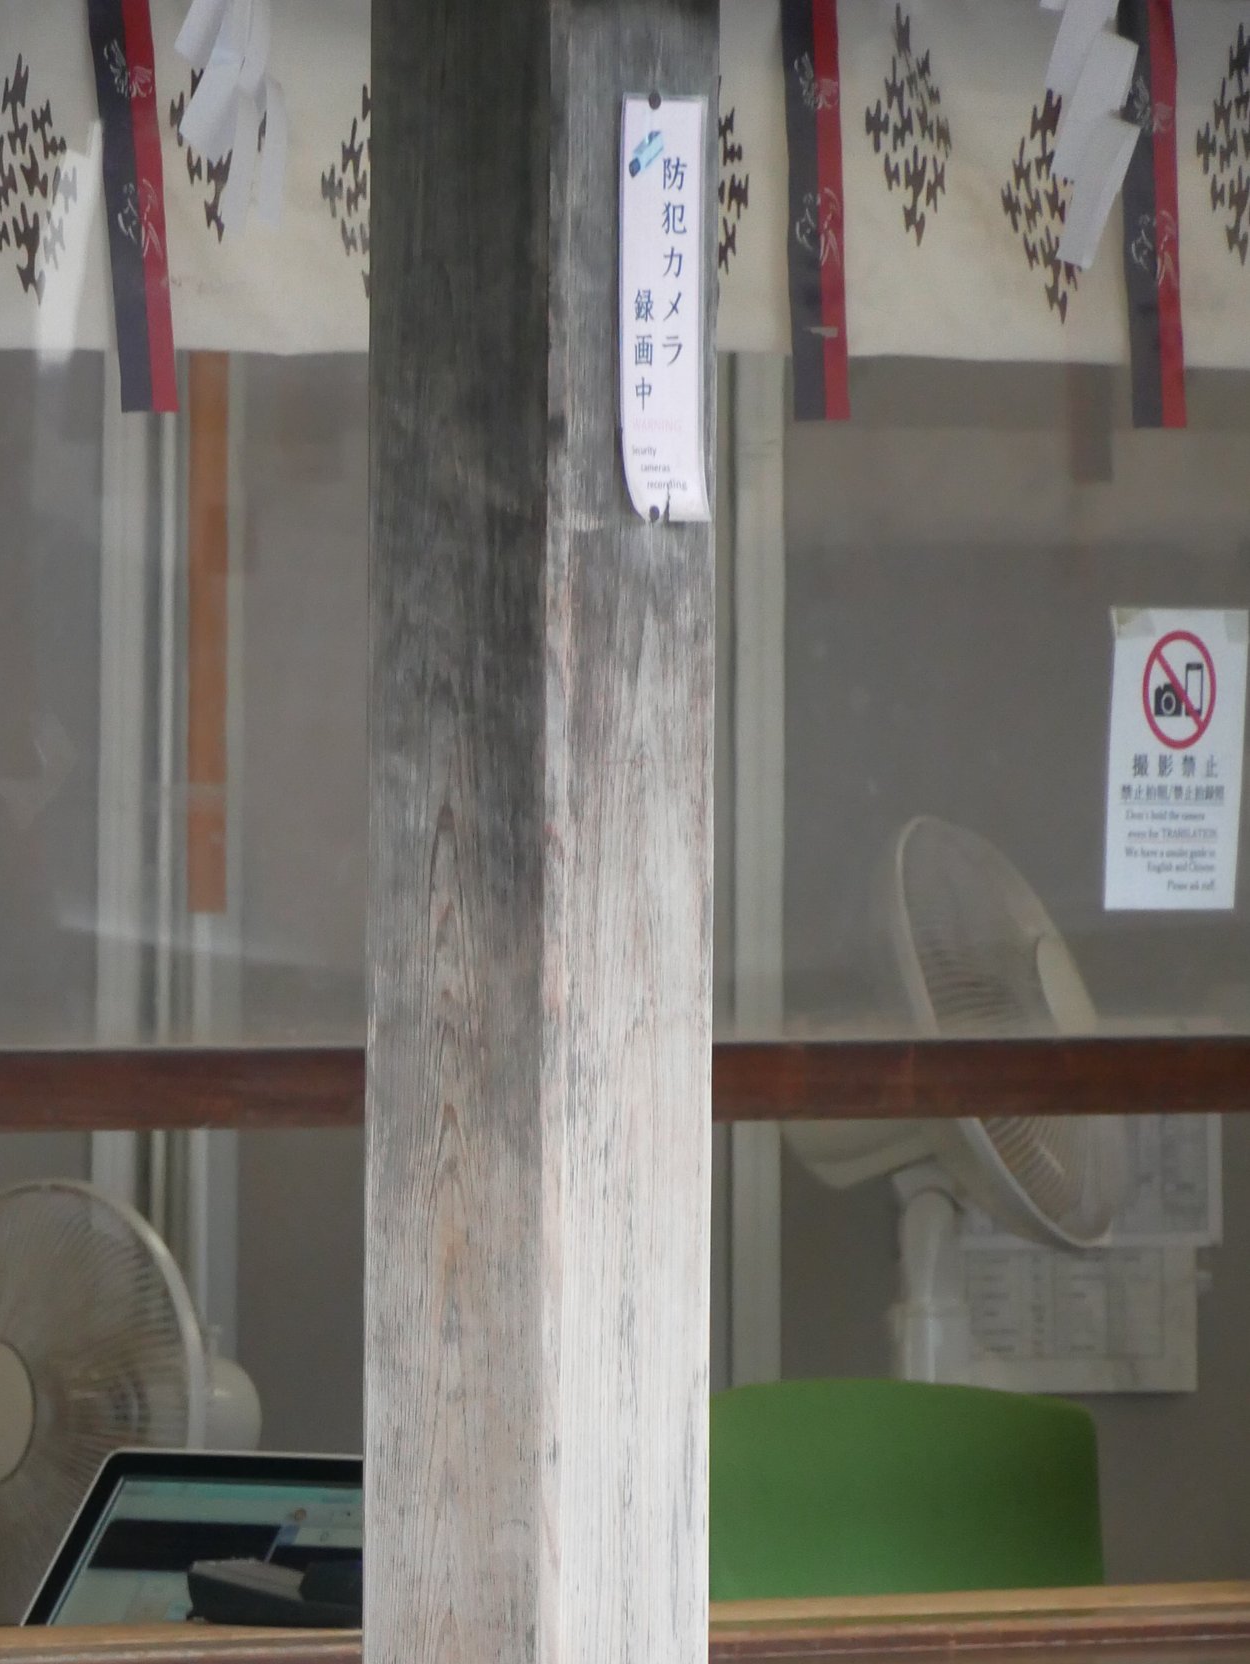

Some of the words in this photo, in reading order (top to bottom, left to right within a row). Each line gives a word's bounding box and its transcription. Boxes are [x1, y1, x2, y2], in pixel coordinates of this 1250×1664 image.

[661, 157, 687, 367] 防犯カメラ
[633, 289, 655, 412] 録画中
[640, 463, 670, 473] cameras
[646, 479, 688, 492] recording
[1133, 754, 1218, 778] 撮影禁止
